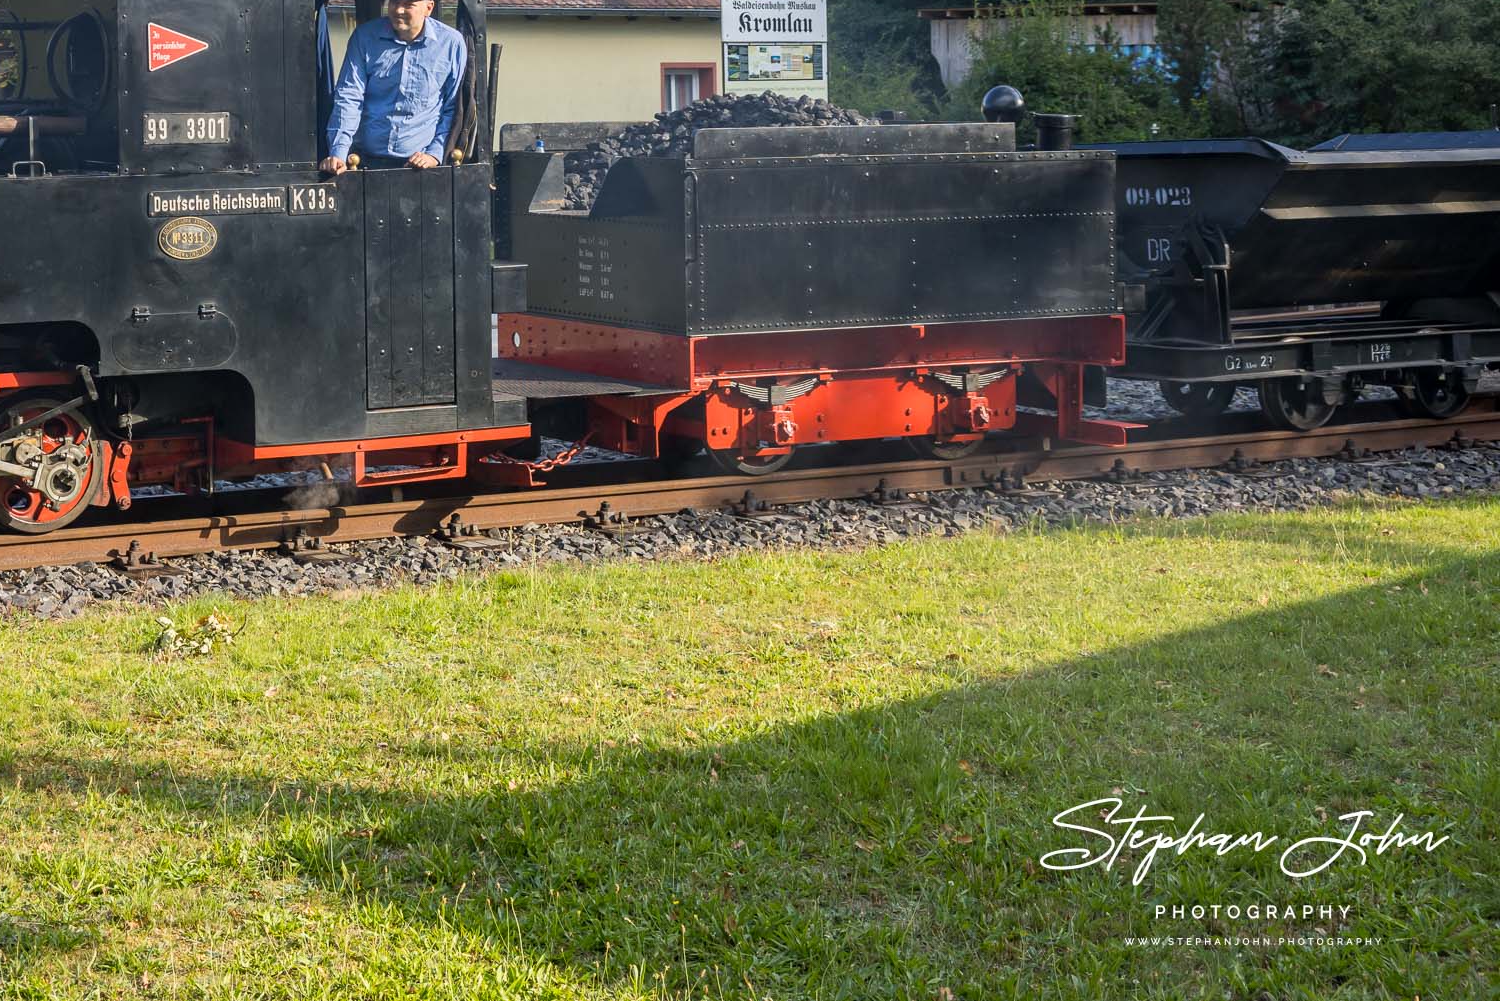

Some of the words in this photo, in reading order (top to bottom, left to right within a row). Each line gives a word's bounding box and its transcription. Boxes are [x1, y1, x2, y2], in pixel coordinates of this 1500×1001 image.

[732, 0, 786, 11] Waldeisenbahn
[787, 0, 817, 11] Muskau
[738, 11, 813, 34] Kromlau
[152, 53, 171, 62] Pflege
[147, 118, 168, 140] 99
[186, 117, 226, 140] 3301
[153, 194, 210, 213] Deutsche
[212, 192, 282, 211] Reichsbahn
[1125, 187, 1191, 206] 09-023
[181, 231, 205, 244] 3311
[1147, 238, 1171, 261] DR
